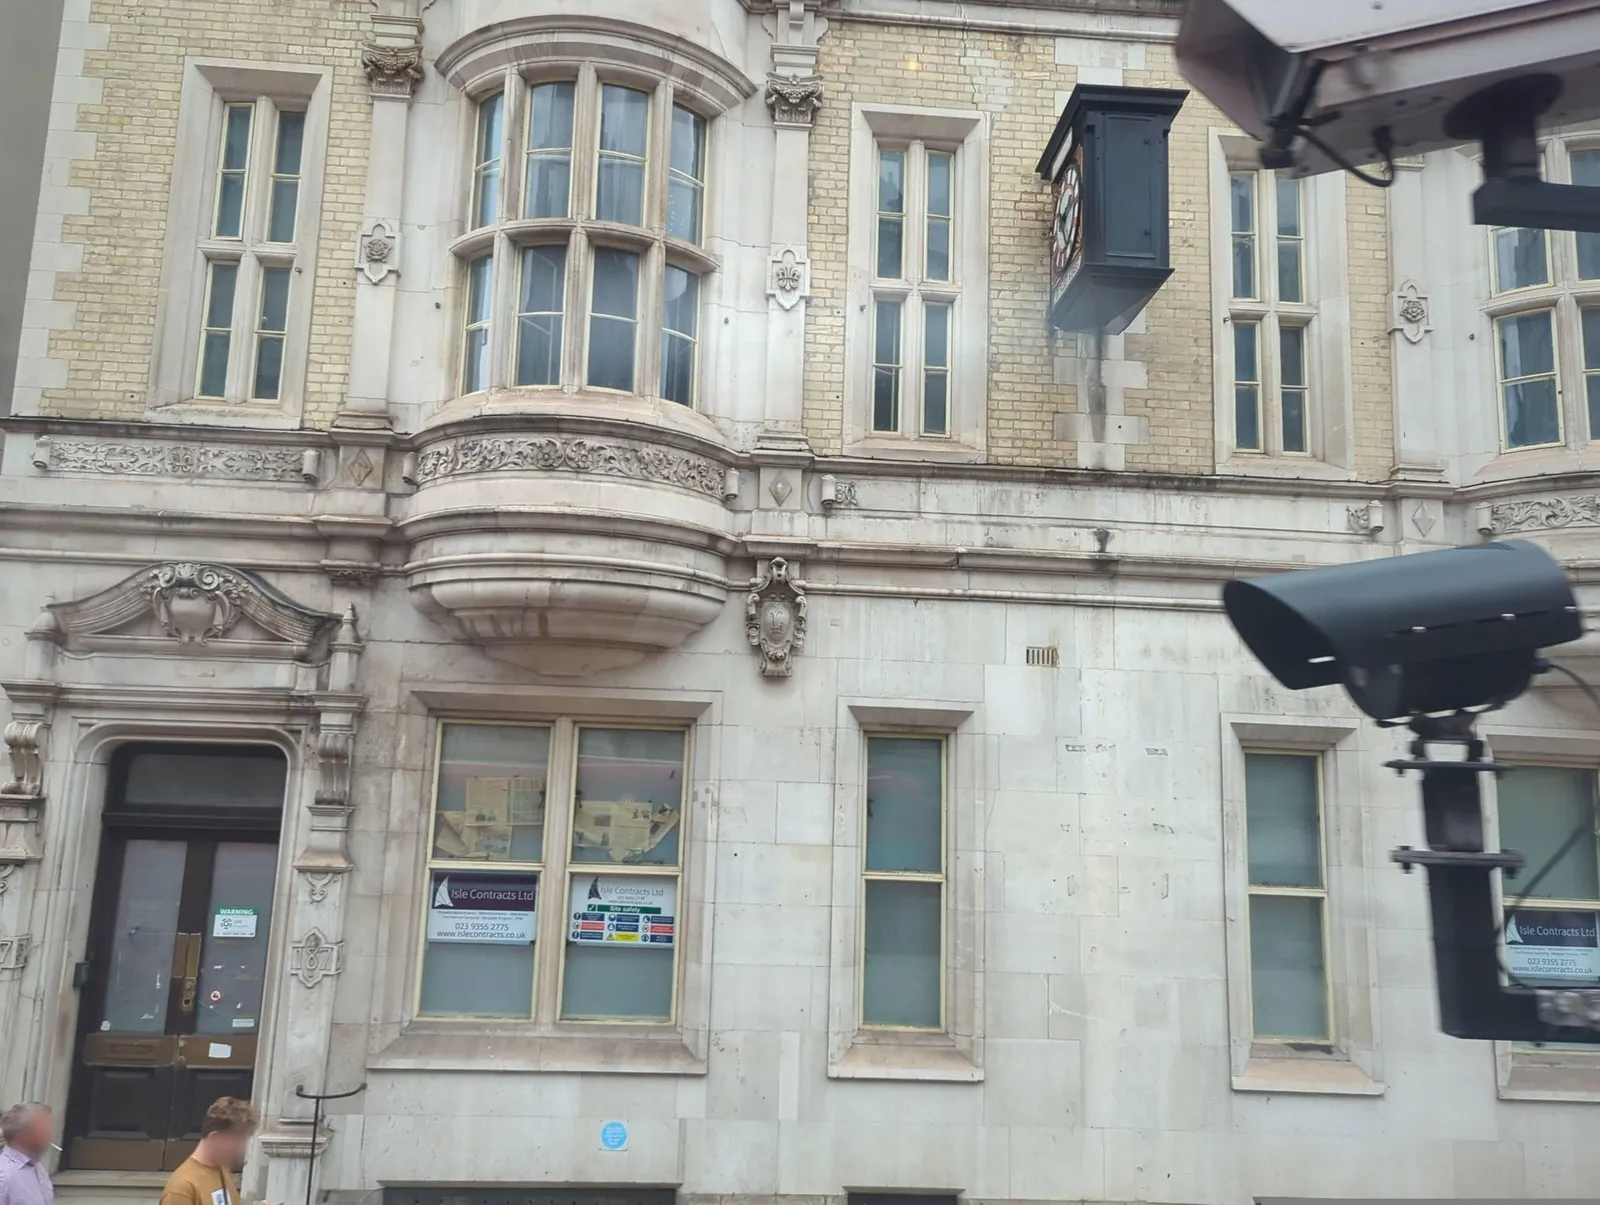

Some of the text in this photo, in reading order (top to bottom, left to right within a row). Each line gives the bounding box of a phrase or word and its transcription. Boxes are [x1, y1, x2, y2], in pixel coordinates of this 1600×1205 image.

[451, 889, 534, 901] Isle Contracts Ltd
[600, 885, 664, 897] Isle Contracts Ltd
[454, 922, 509, 931] 023 9355 2775
[1519, 925, 1595, 937] Isle Contracts Ltd
[436, 930, 526, 939] www.islecontracts.co.uk
[1527, 957, 1577, 966] 023 9355 2775
[1512, 965, 1594, 974] www.islecontracts.co.uk
